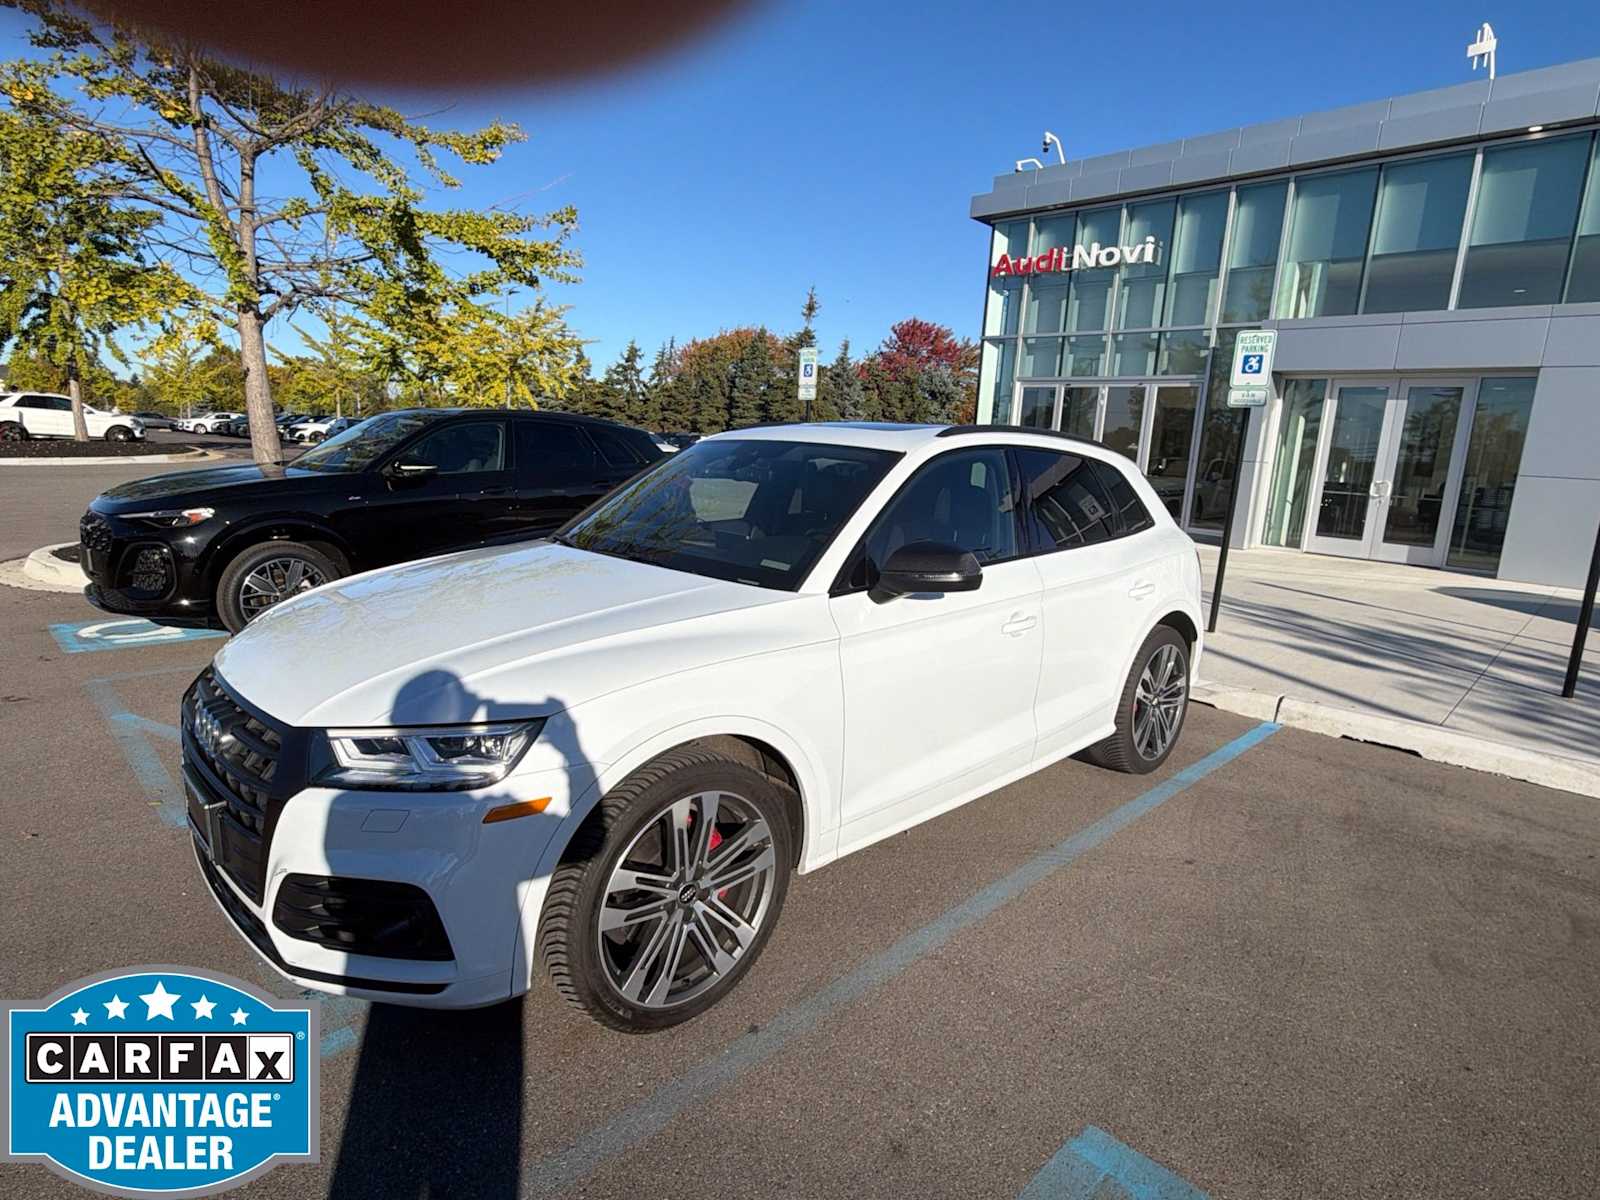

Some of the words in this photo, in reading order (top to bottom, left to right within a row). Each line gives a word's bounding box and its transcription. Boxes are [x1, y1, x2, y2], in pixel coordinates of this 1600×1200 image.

[991, 247, 1067, 277] Audi
[1072, 235, 1156, 270] Novi
[1240, 335, 1272, 343] RESERVED
[1241, 344, 1268, 352] PARKING
